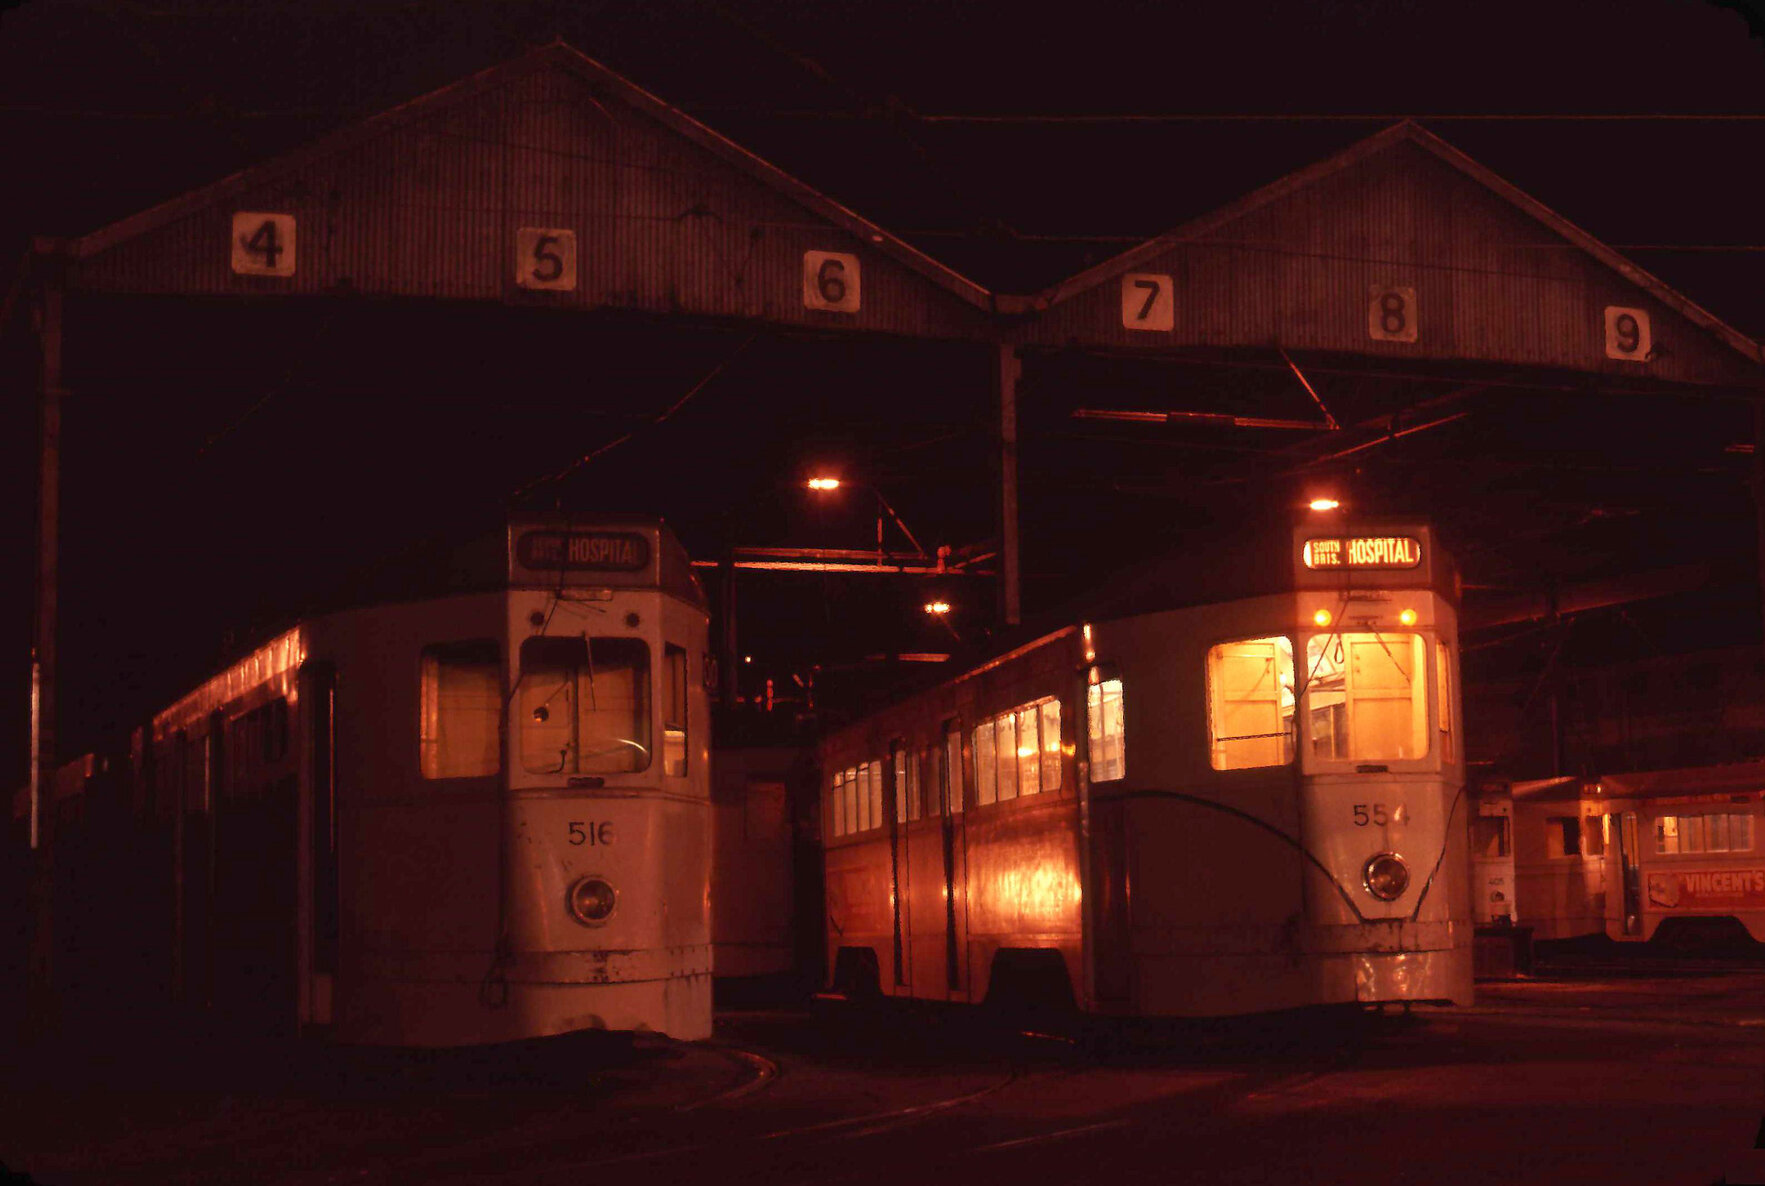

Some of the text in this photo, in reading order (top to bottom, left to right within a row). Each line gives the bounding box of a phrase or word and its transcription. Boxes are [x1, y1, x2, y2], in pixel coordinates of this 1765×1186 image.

[240, 220, 283, 268] 4
[532, 235, 563, 281] 5
[818, 259, 846, 303] 6
[1134, 280, 1160, 320] 7
[1380, 293, 1406, 333] 8
[1616, 314, 1640, 353] 9
[568, 537, 638, 565] HOSPITAL
[1313, 541, 1340, 553] SOUTH
[1346, 538, 1414, 564] HOSPITAL
[569, 821, 613, 846] 516
